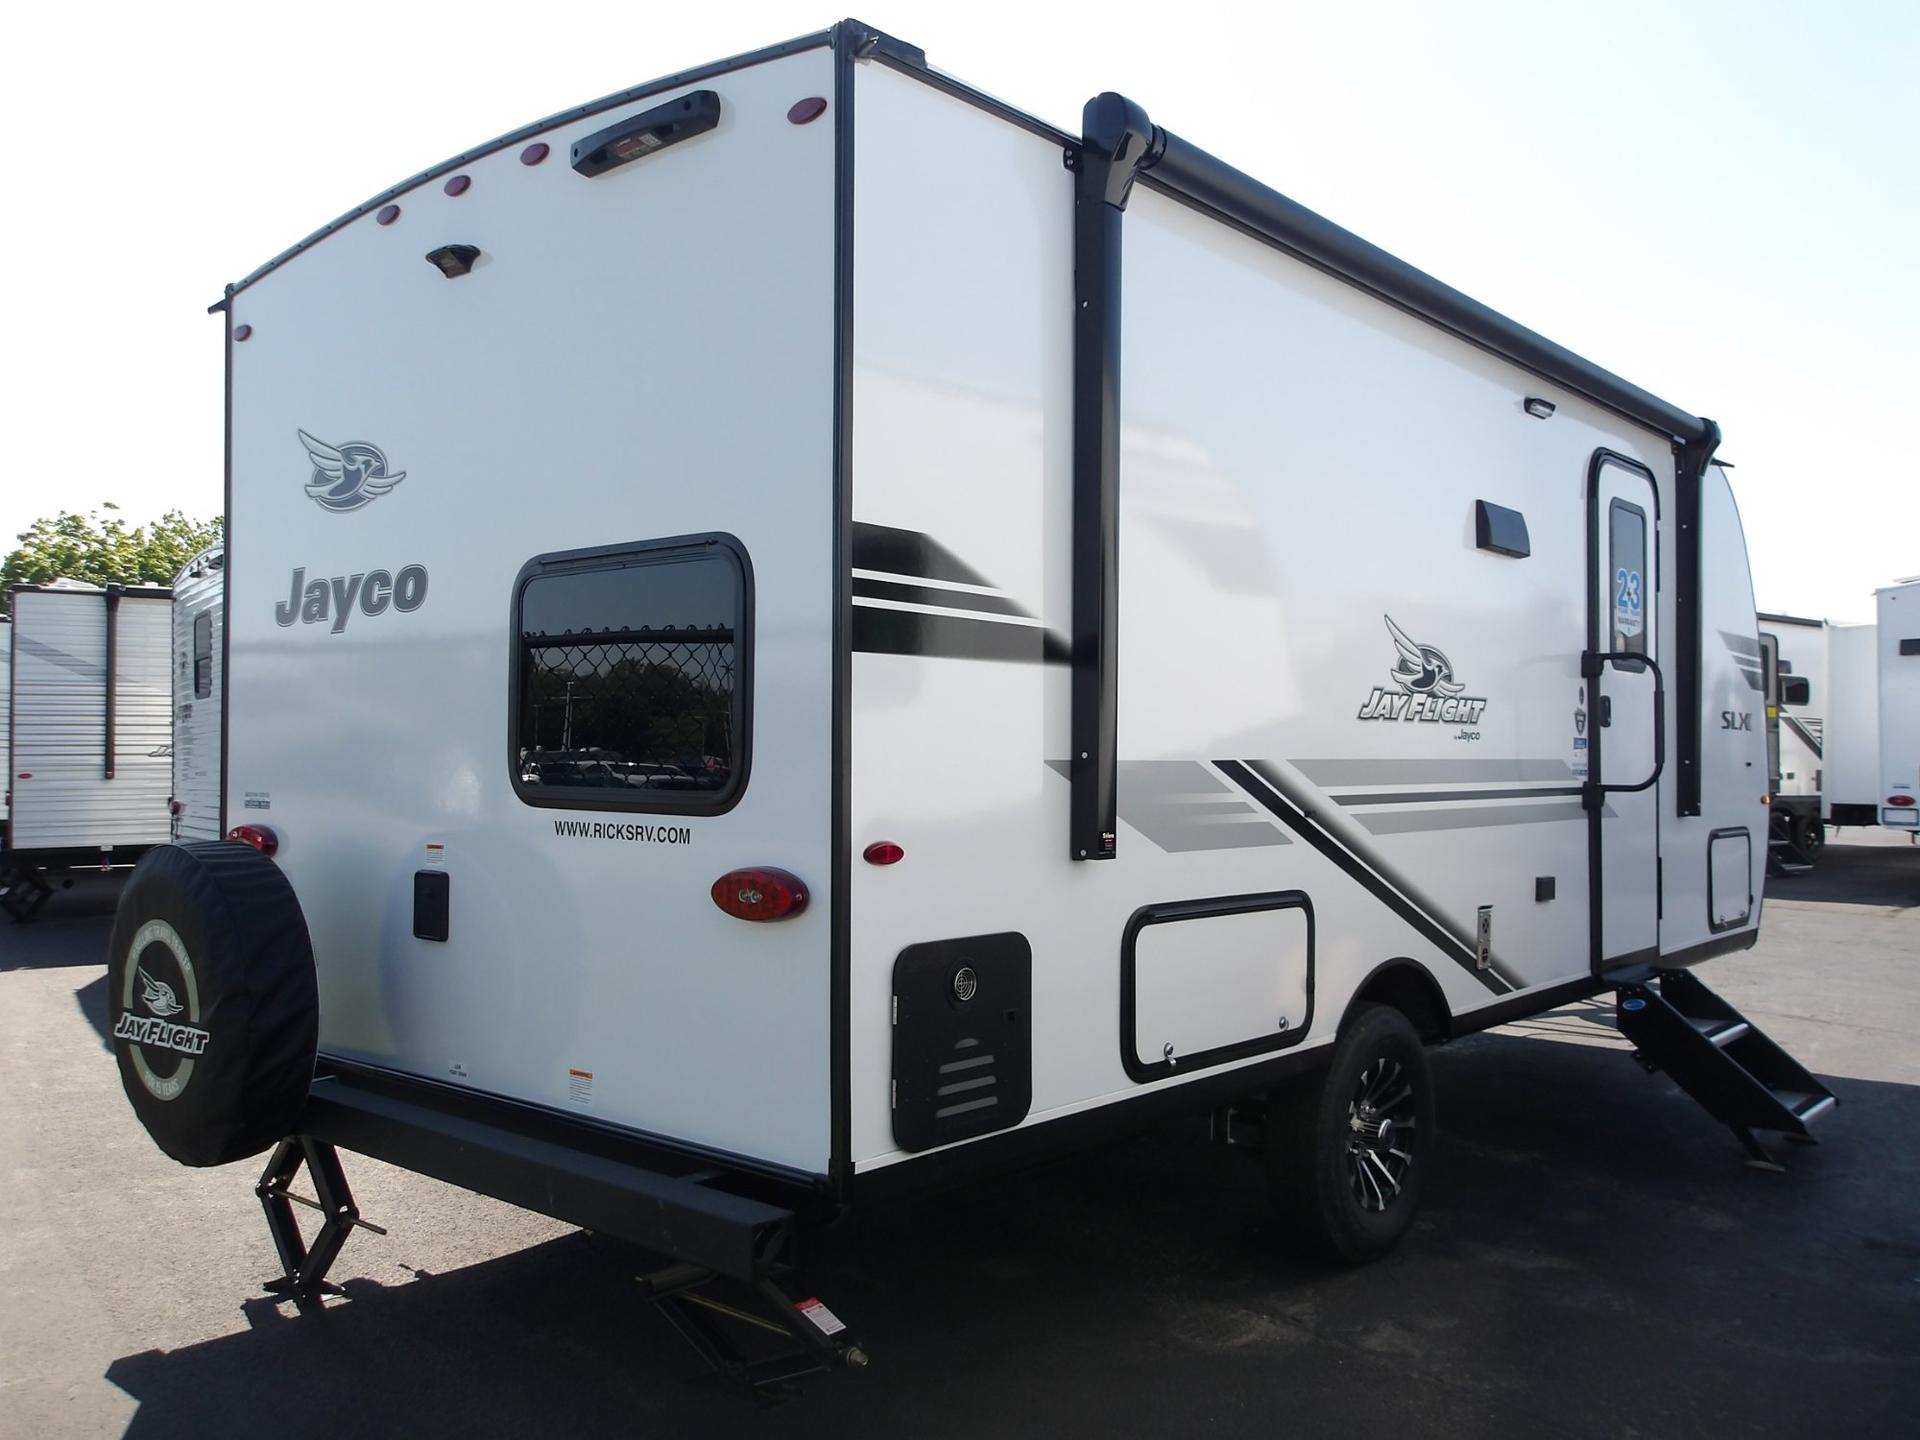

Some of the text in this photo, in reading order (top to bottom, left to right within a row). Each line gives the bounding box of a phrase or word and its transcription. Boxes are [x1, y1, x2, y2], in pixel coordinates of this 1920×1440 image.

[275, 563, 429, 634] Jayco
[1721, 710, 1752, 732] SLX
[1457, 729, 1481, 742] Jayco
[554, 820, 691, 845] WWW.RICKSRV.COM
